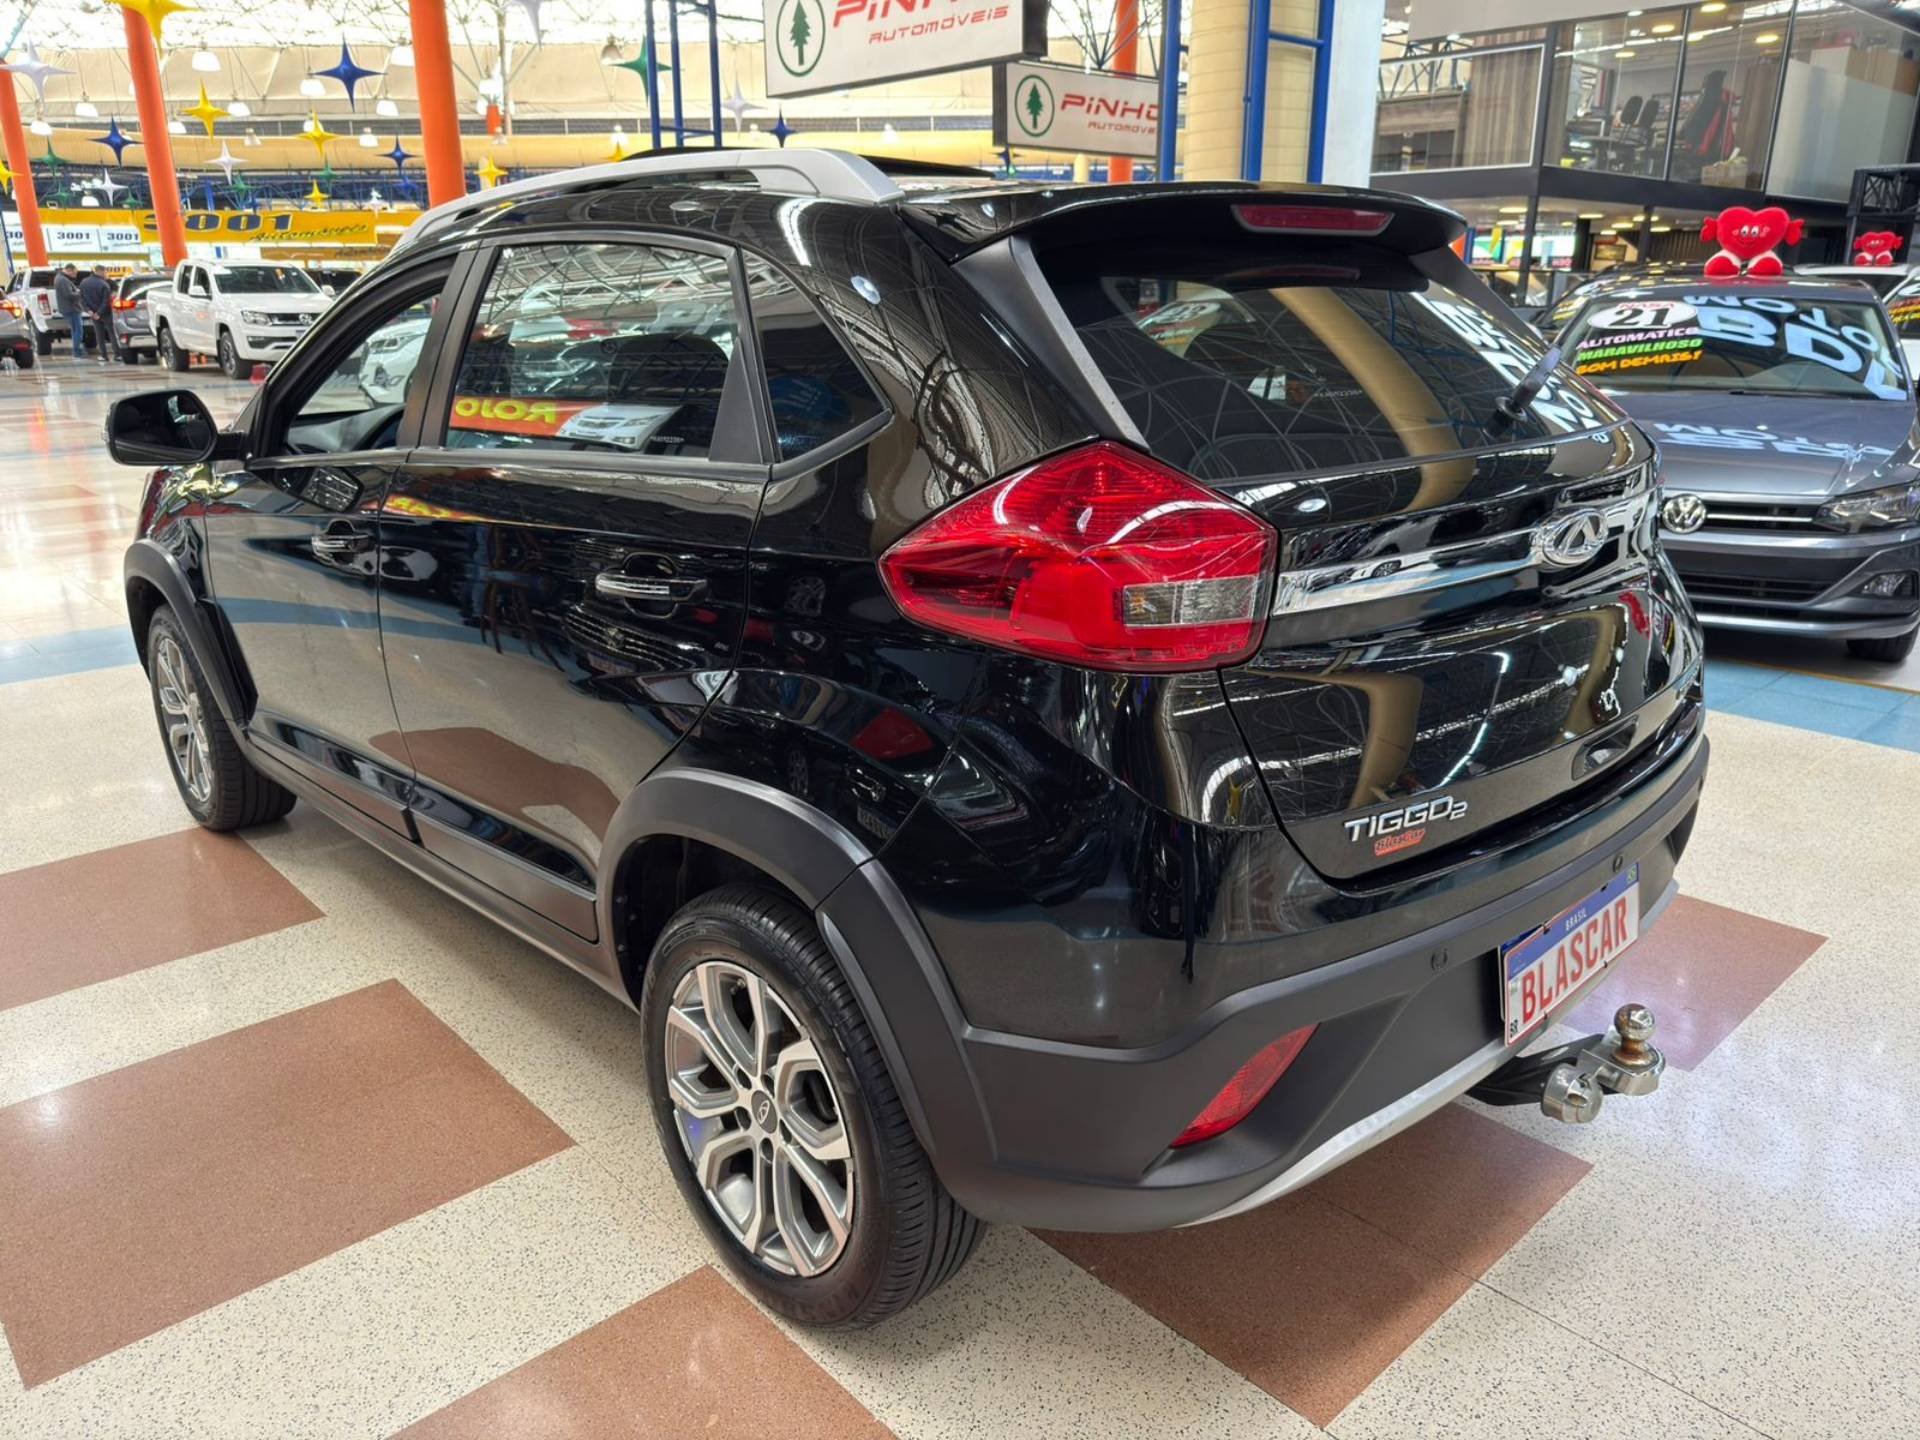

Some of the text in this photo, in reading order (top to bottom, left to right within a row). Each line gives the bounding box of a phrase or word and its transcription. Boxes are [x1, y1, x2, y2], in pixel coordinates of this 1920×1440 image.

[833, 0, 958, 28] PIN
[57, 231, 91, 240] 3001
[107, 232, 139, 241] 3001
[1608, 307, 1671, 327] 21
[1577, 338, 1703, 361] MARAVILHOSO
[1565, 907, 1588, 932] BRASIL
[1522, 895, 1628, 1024] BLASCAR
